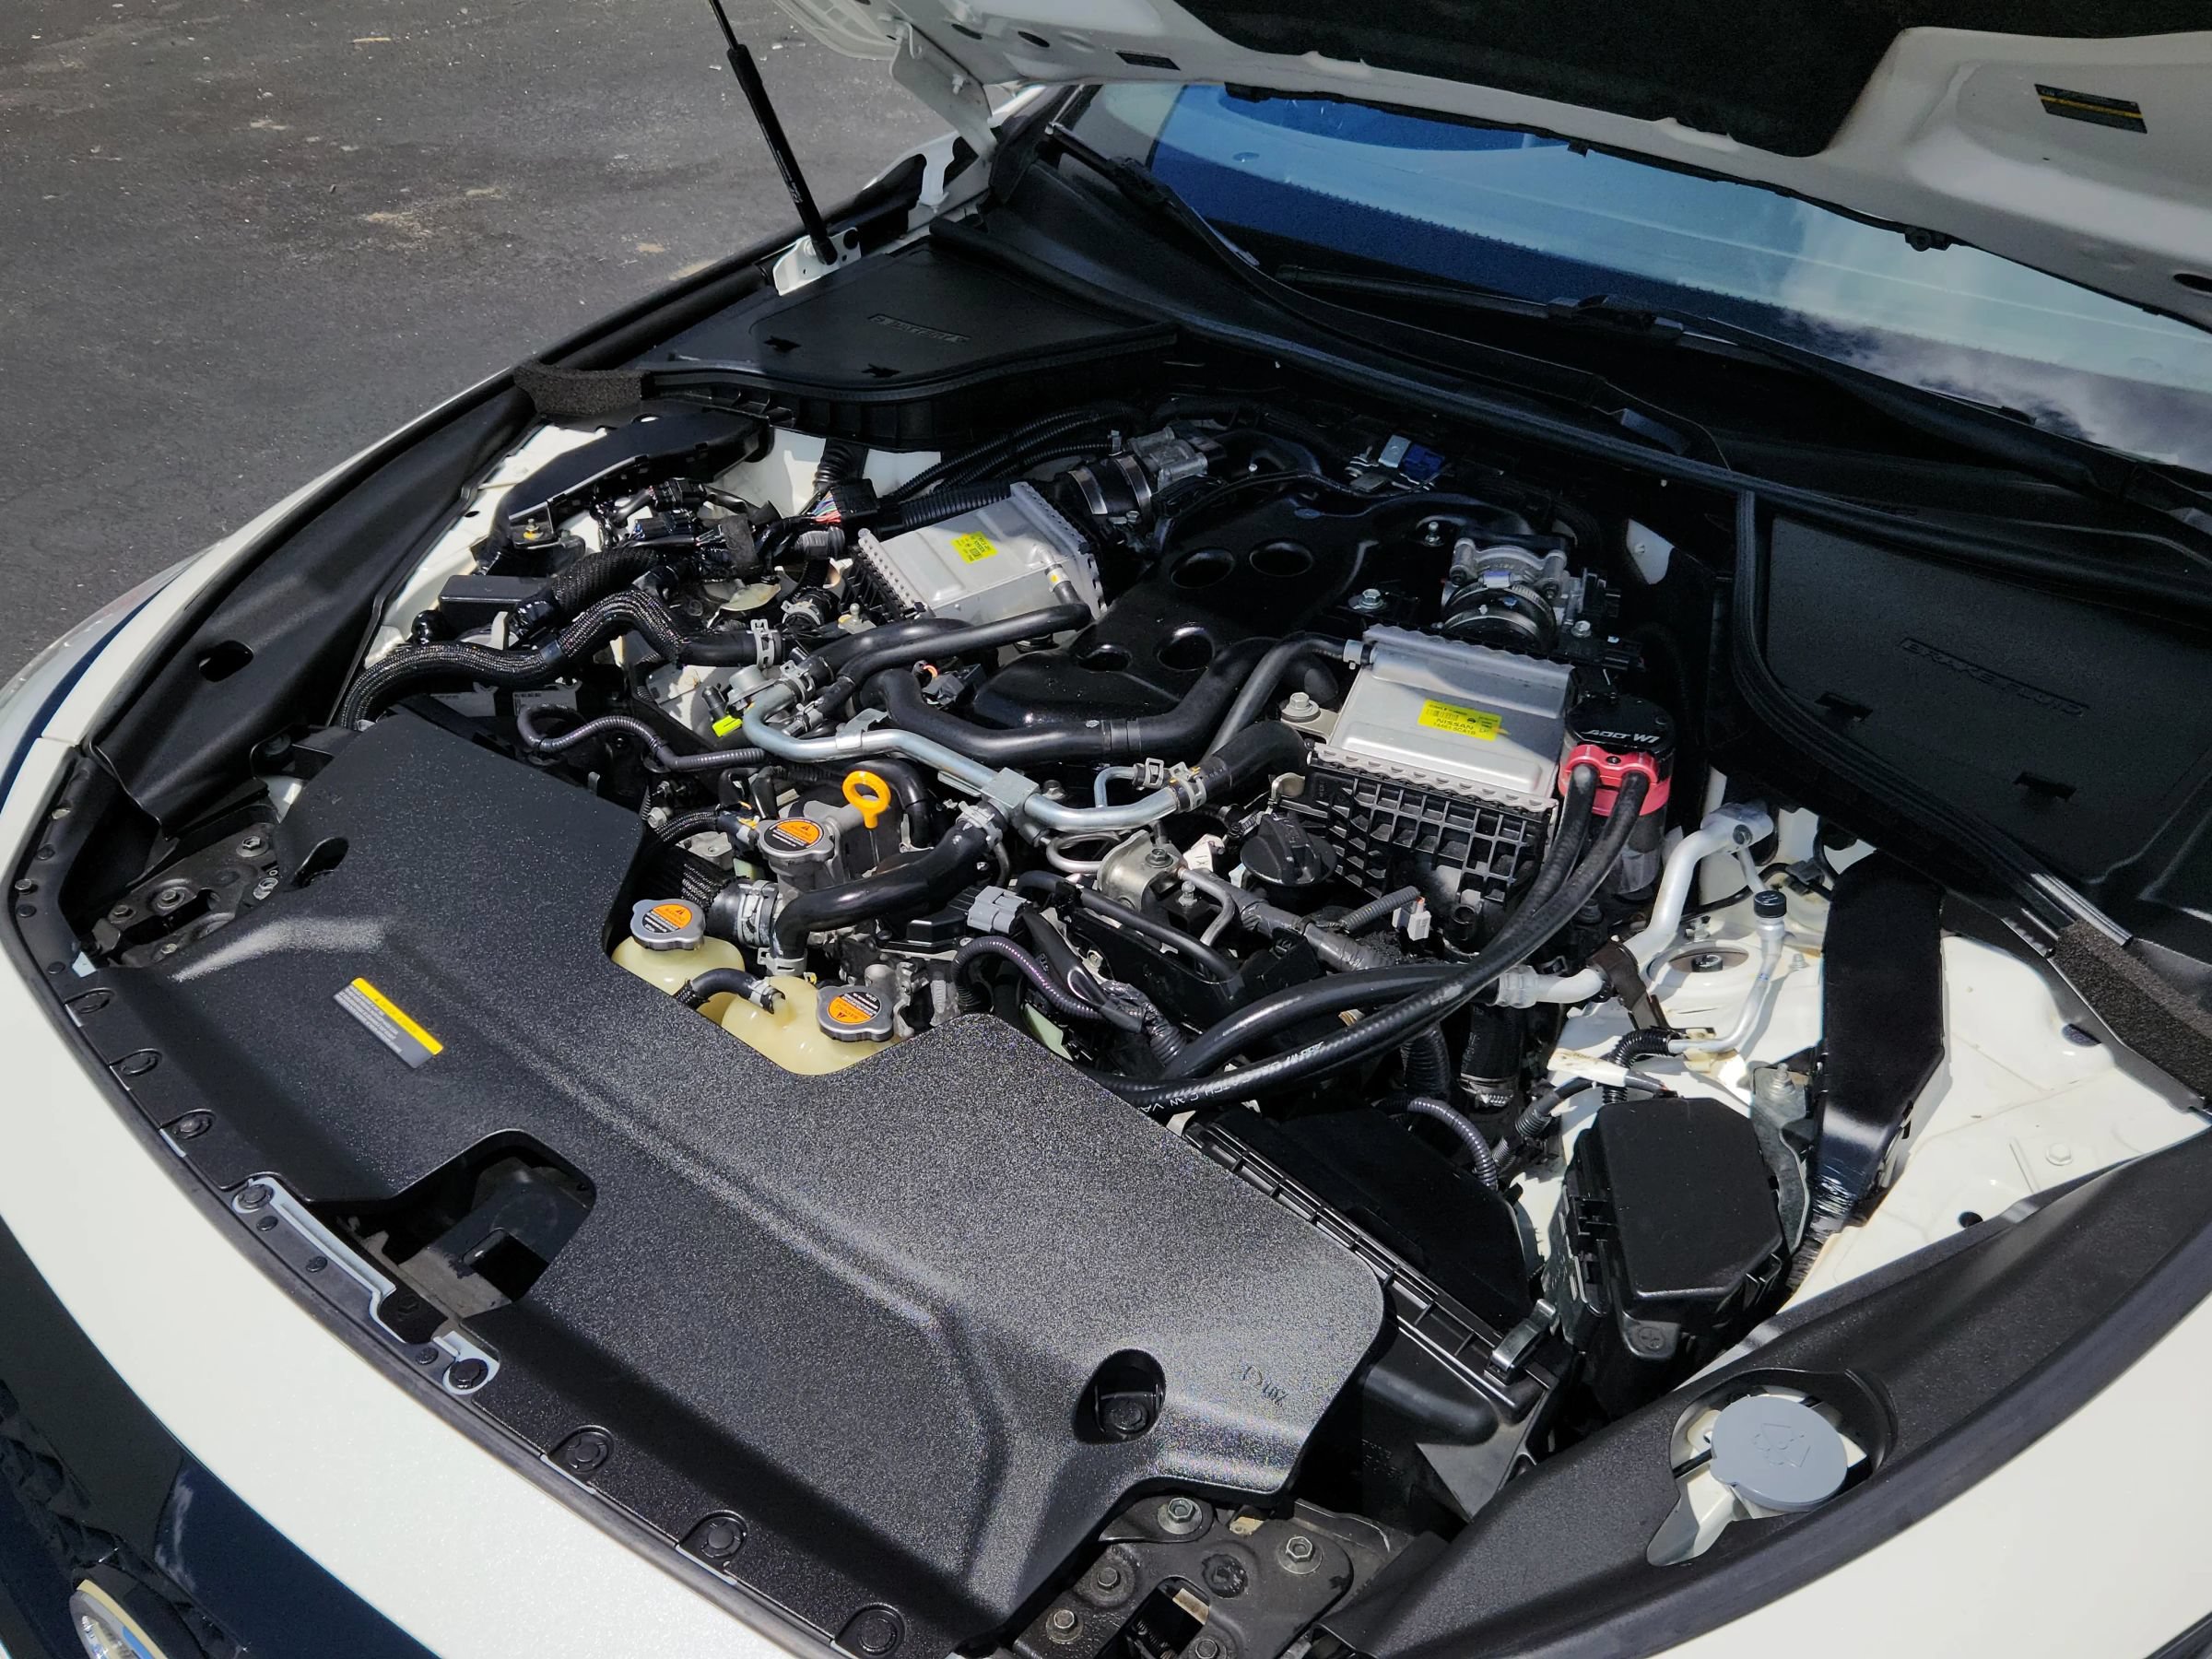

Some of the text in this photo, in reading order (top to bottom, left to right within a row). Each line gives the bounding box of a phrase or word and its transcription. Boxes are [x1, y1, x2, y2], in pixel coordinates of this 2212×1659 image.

[1901, 643, 1997, 686] BRAKE
[1436, 719, 1475, 730] NISSAN
[1170, 1092, 1199, 1107] CAN
